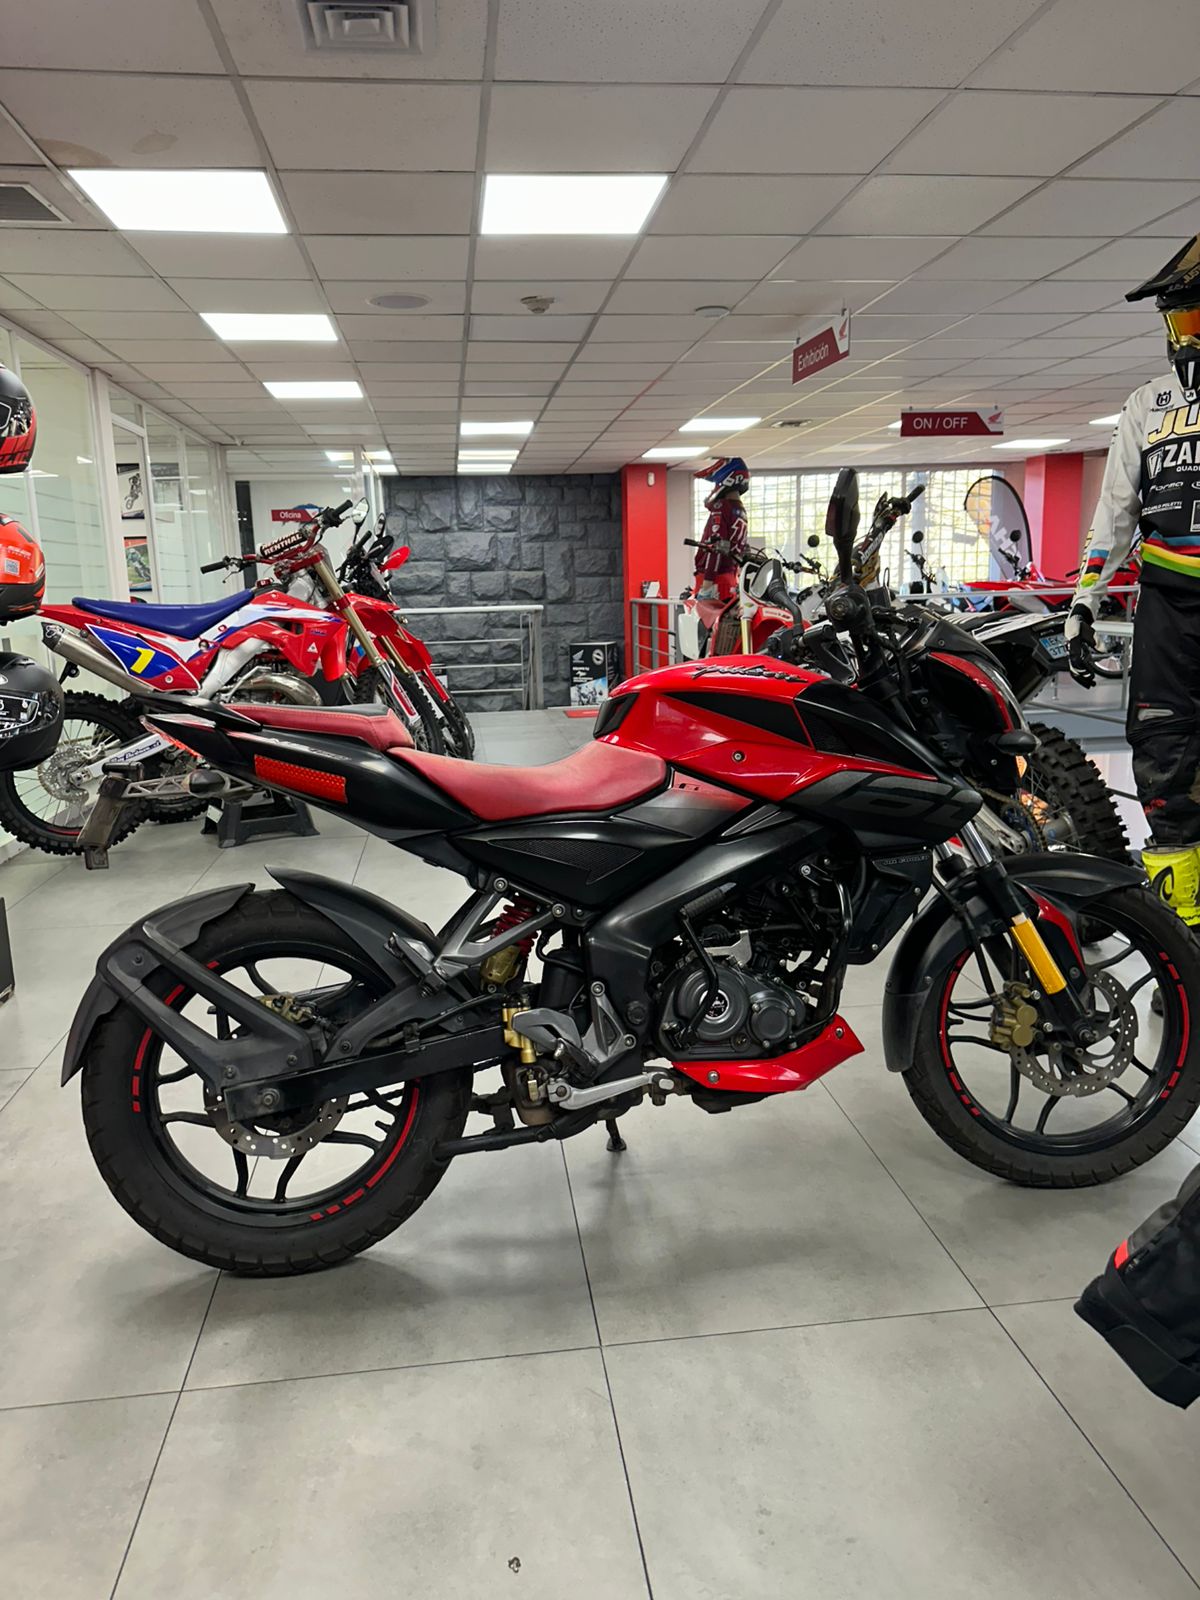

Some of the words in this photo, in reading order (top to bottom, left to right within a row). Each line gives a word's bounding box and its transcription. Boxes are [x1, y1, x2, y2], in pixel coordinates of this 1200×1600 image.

[798, 343, 829, 371] Exhibición
[913, 417, 932, 430] ON
[934, 417, 941, 430] /
[943, 417, 968, 430] OFF
[1163, 440, 1200, 469] ZA
[279, 511, 302, 519] Oficina
[264, 533, 303, 556] RENTHAL
[130, 646, 156, 674] 1
